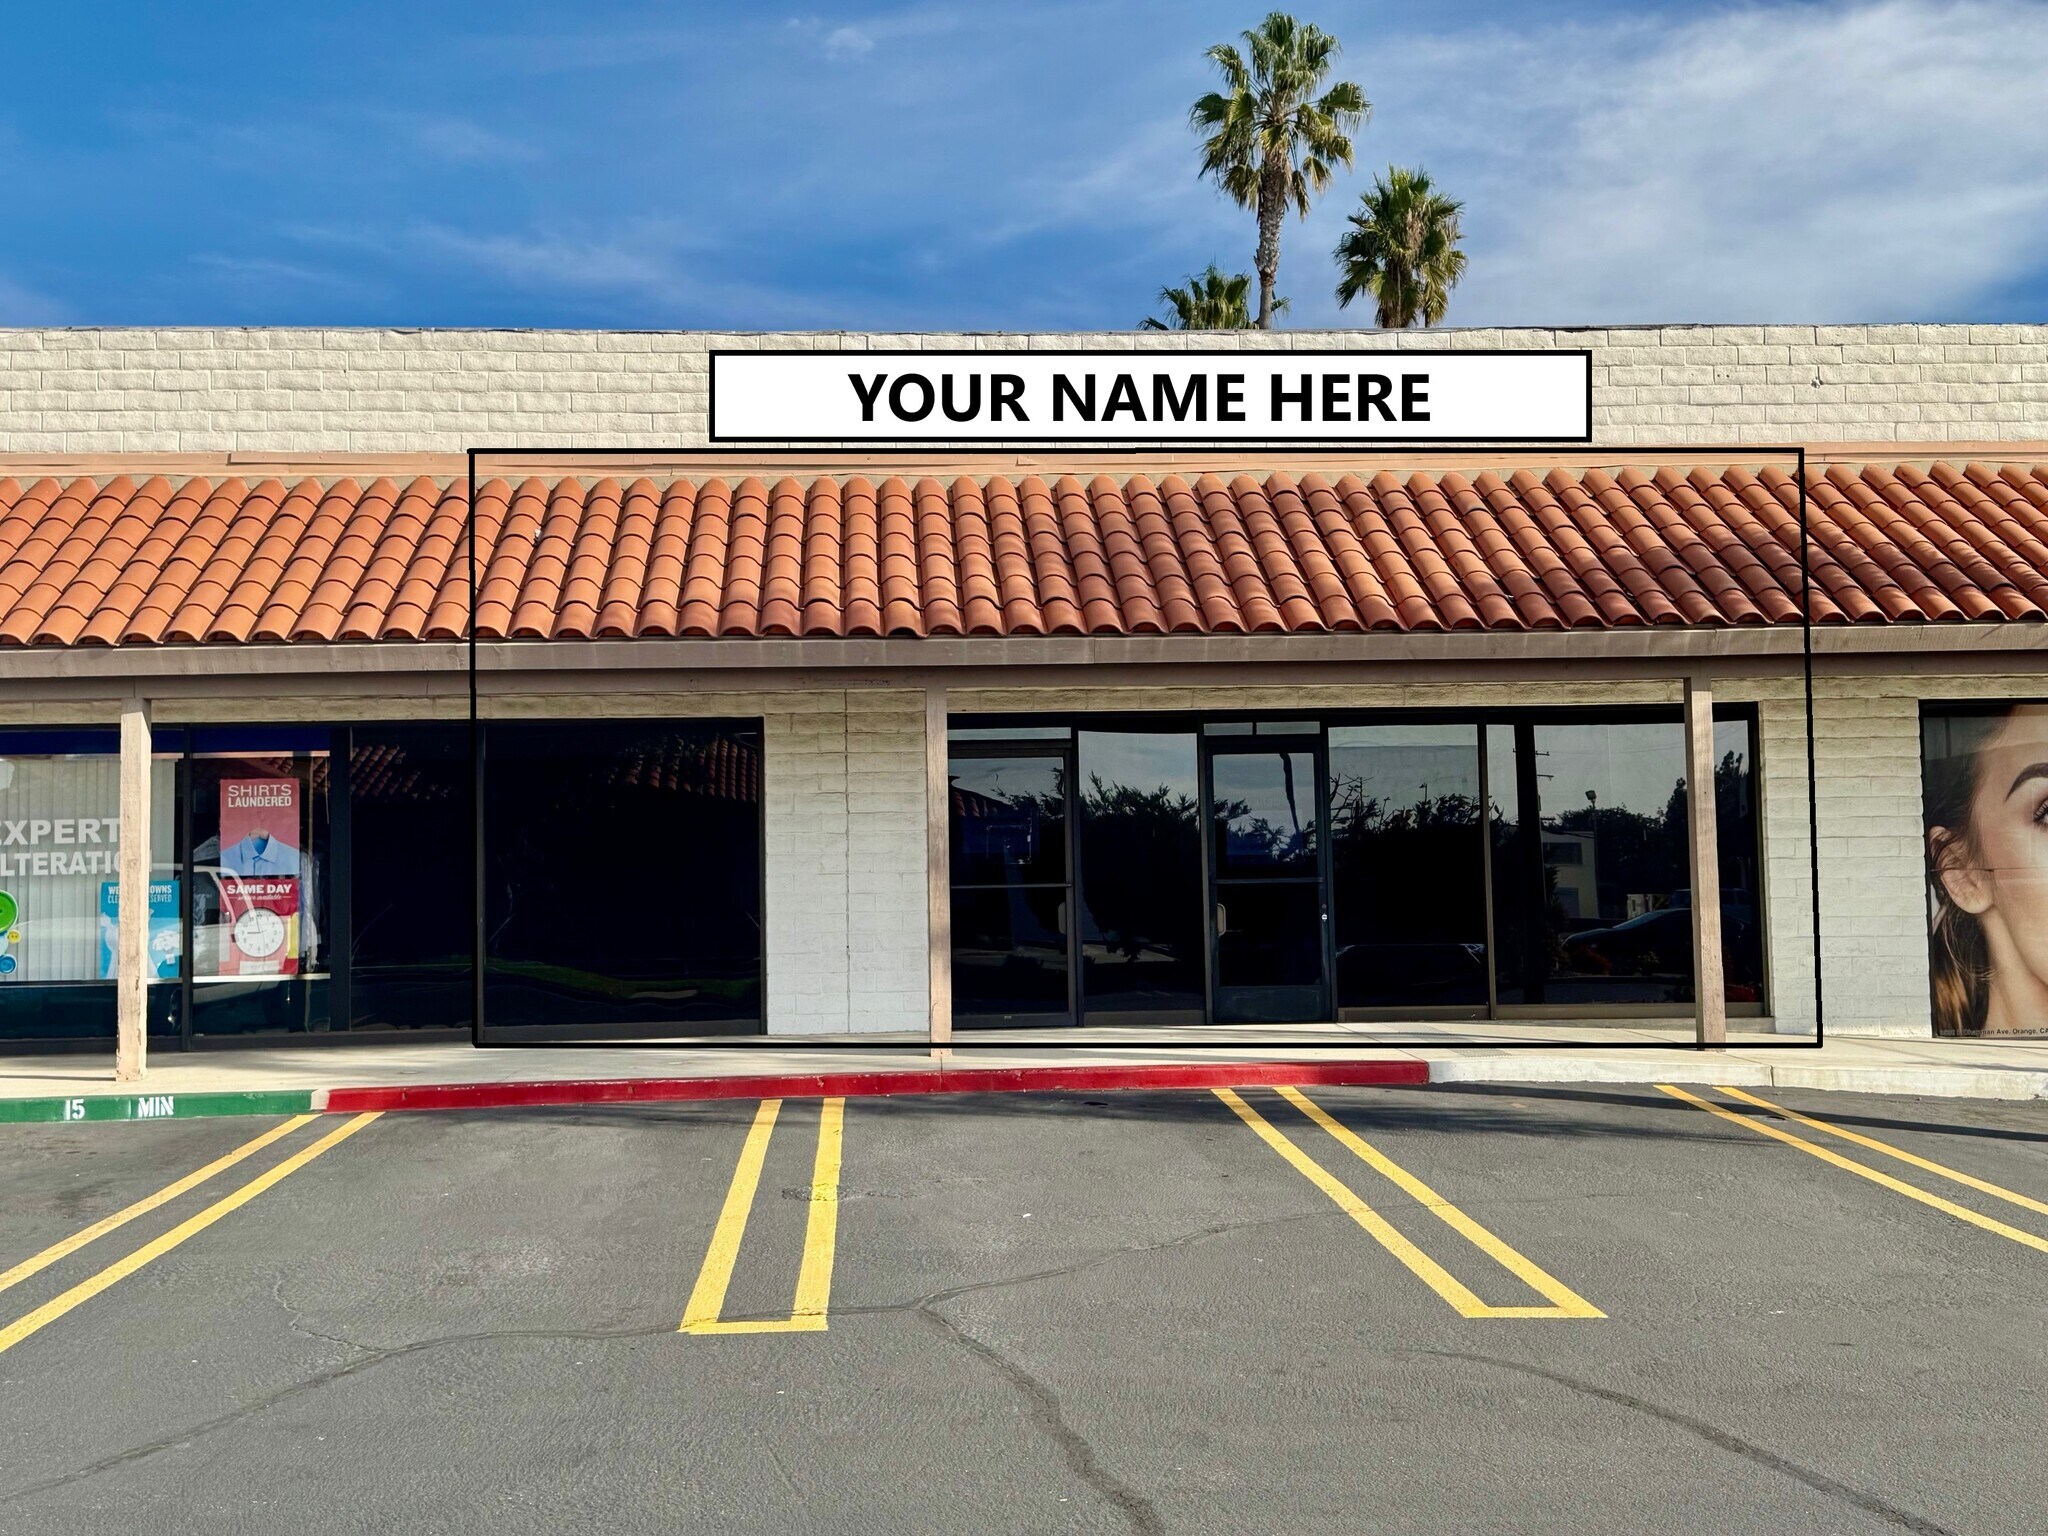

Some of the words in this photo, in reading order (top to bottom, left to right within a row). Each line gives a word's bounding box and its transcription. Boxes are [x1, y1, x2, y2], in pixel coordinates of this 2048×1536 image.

[228, 784, 292, 797] SHIRTS
[228, 796, 292, 808] LAUNDERED
[0, 818, 120, 846] XPERT
[226, 884, 264, 895] SAME
[267, 884, 292, 894] DAY
[64, 1099, 86, 1120] 15
[138, 1096, 174, 1118] MIN
